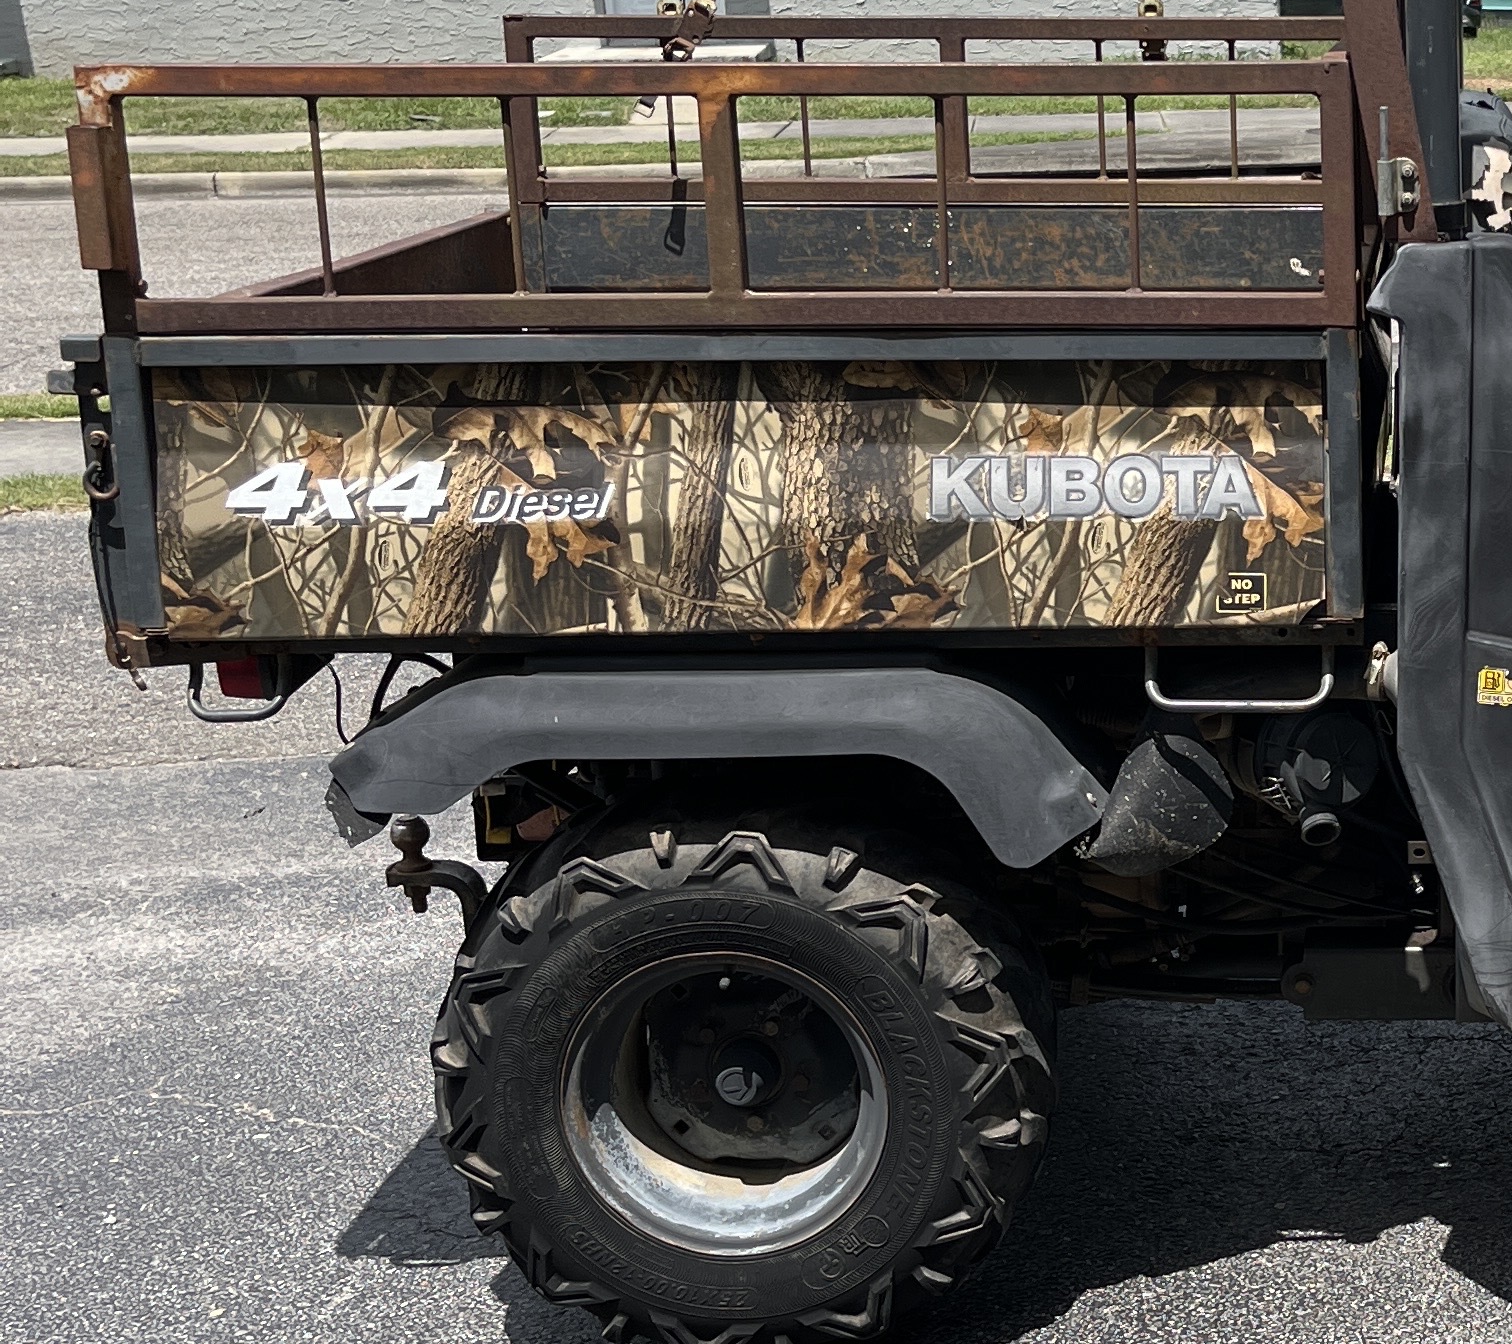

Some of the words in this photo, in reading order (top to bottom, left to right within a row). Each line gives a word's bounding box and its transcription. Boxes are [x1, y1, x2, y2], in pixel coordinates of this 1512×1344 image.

[928, 453, 1265, 520] KUBOTA
[226, 460, 449, 526] 4x4
[473, 482, 617, 523] Diesel
[1230, 578, 1253, 590] NO
[1223, 593, 1261, 604] STEP
[1481, 695, 1504, 703] DIESEL
